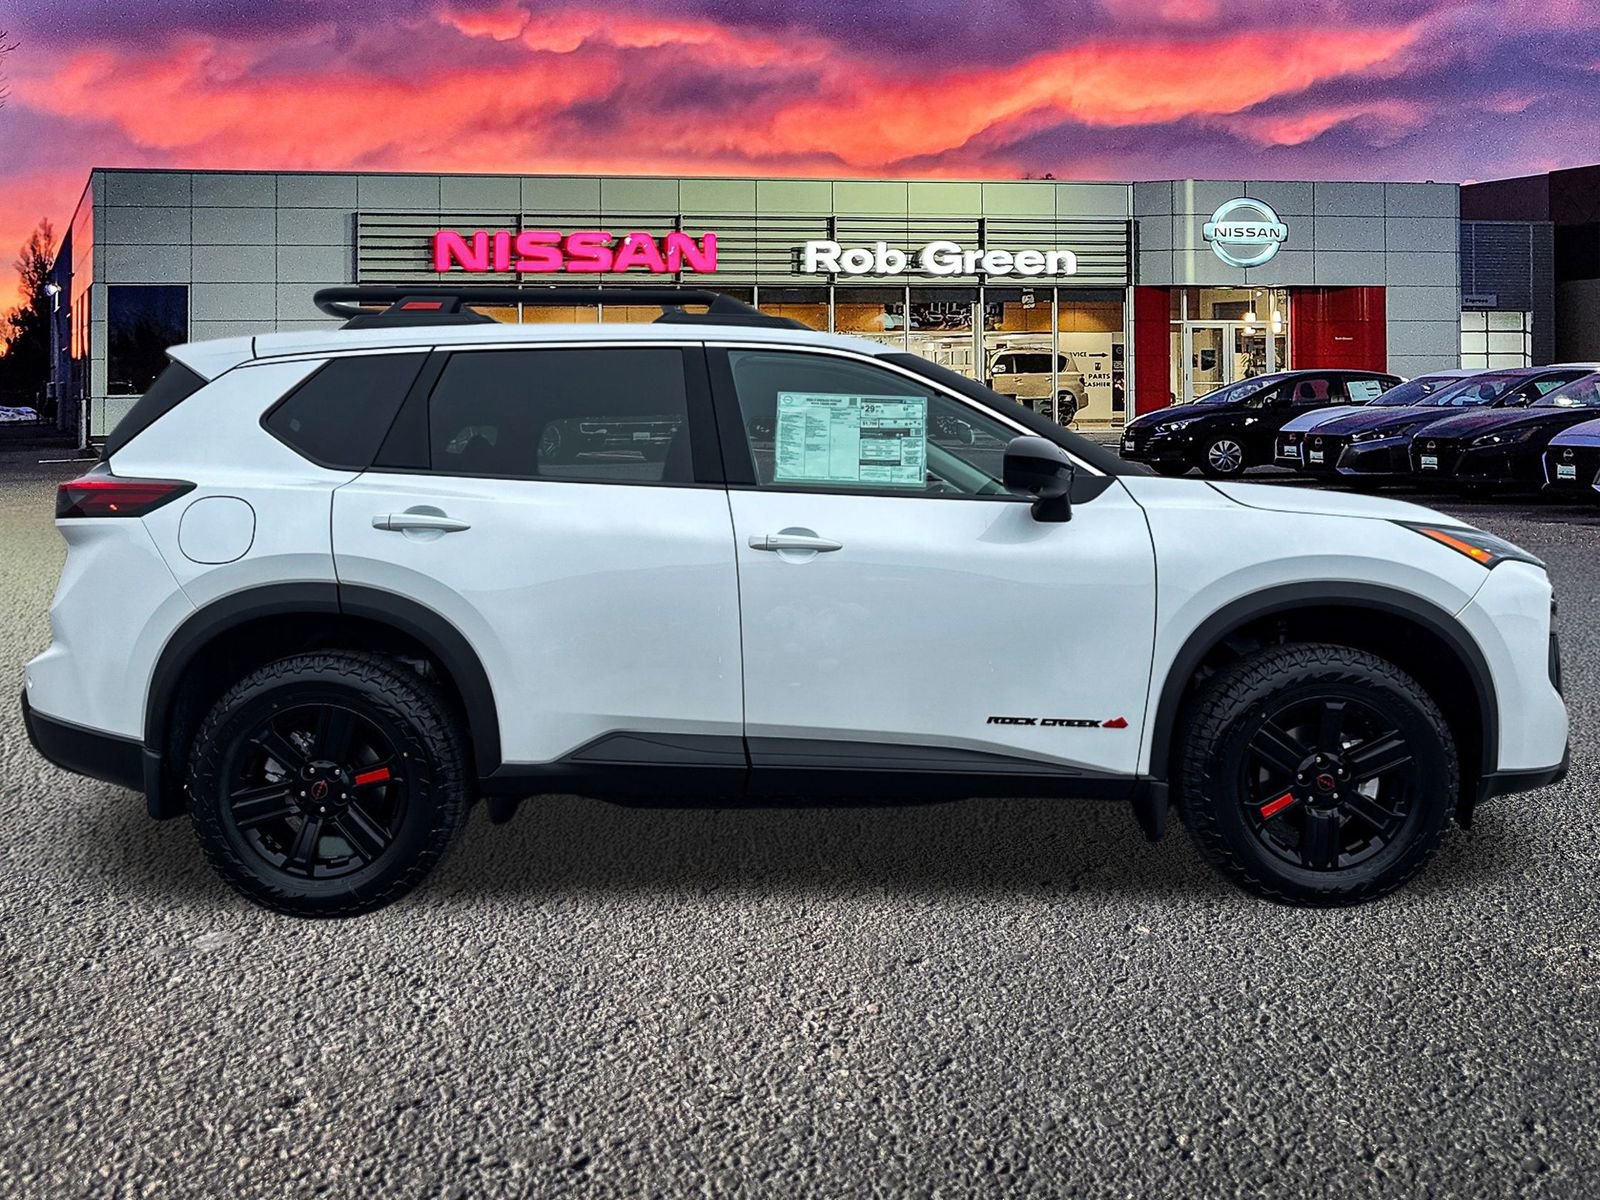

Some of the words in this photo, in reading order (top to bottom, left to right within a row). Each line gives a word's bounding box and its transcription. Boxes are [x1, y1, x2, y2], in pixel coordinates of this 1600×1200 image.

[1214, 228, 1280, 238] NISSAN
[434, 231, 718, 273] NISSAN
[803, 240, 907, 275] Rob
[920, 240, 1078, 276] Green
[986, 716, 1038, 726] ROCK
[1040, 718, 1102, 728] CREEK
